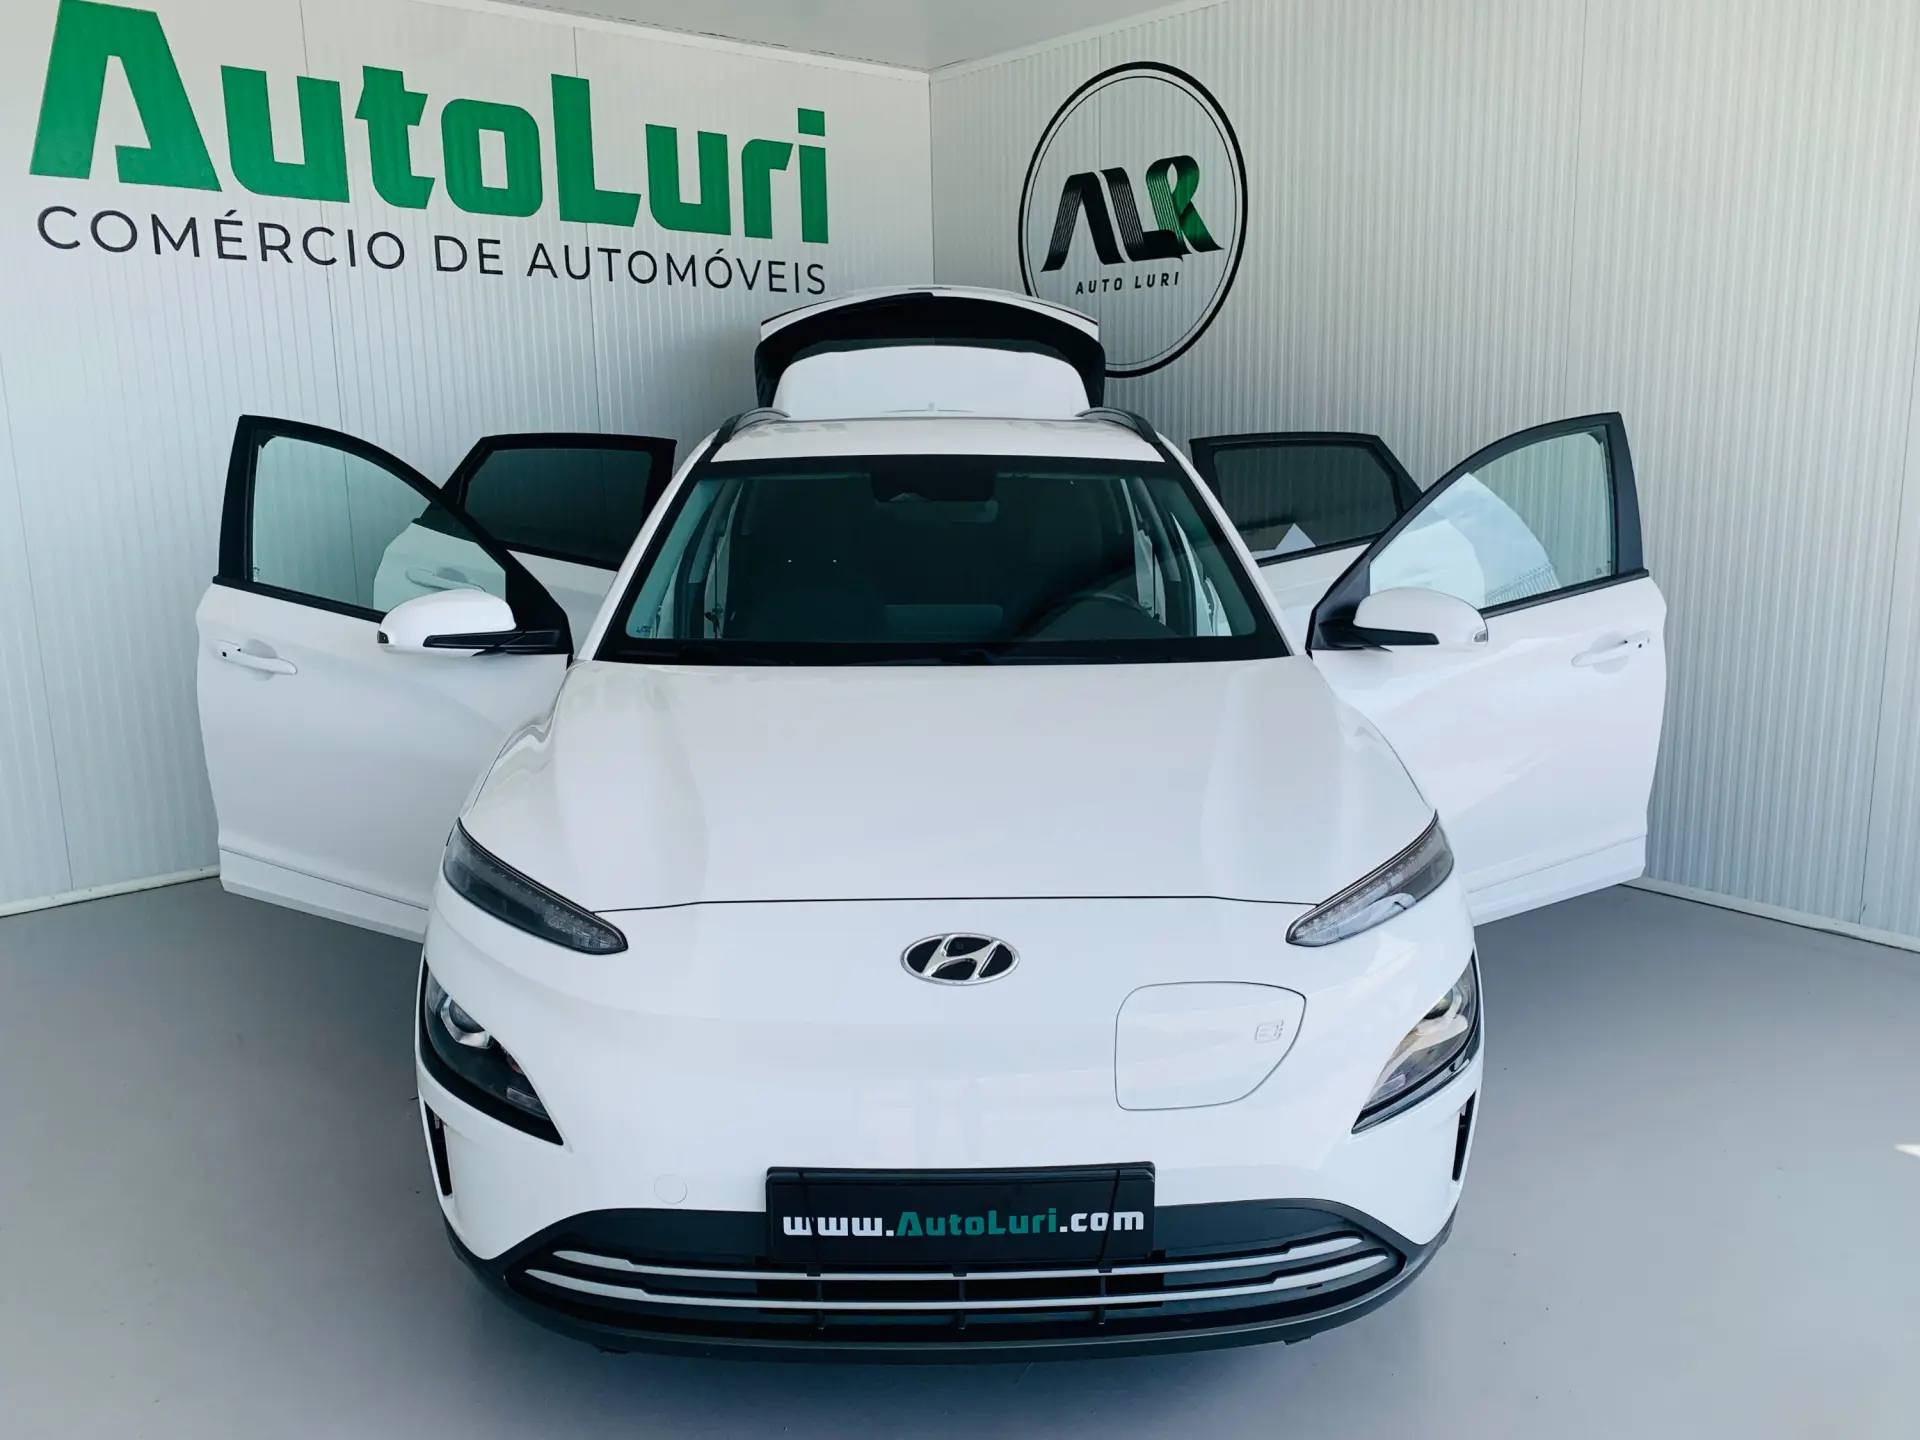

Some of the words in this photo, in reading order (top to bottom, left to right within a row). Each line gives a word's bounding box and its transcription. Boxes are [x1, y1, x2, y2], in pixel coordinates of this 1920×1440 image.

[30, 0, 829, 243] AutoLuri
[37, 205, 407, 270] COMÉRCIO
[434, 235, 504, 275] DE
[527, 244, 827, 295] AUTOMÓVEIS
[1076, 277, 1123, 295] AUTO
[1134, 271, 1180, 289] LURI
[782, 1207, 1145, 1237] www.AutoLuri.com
